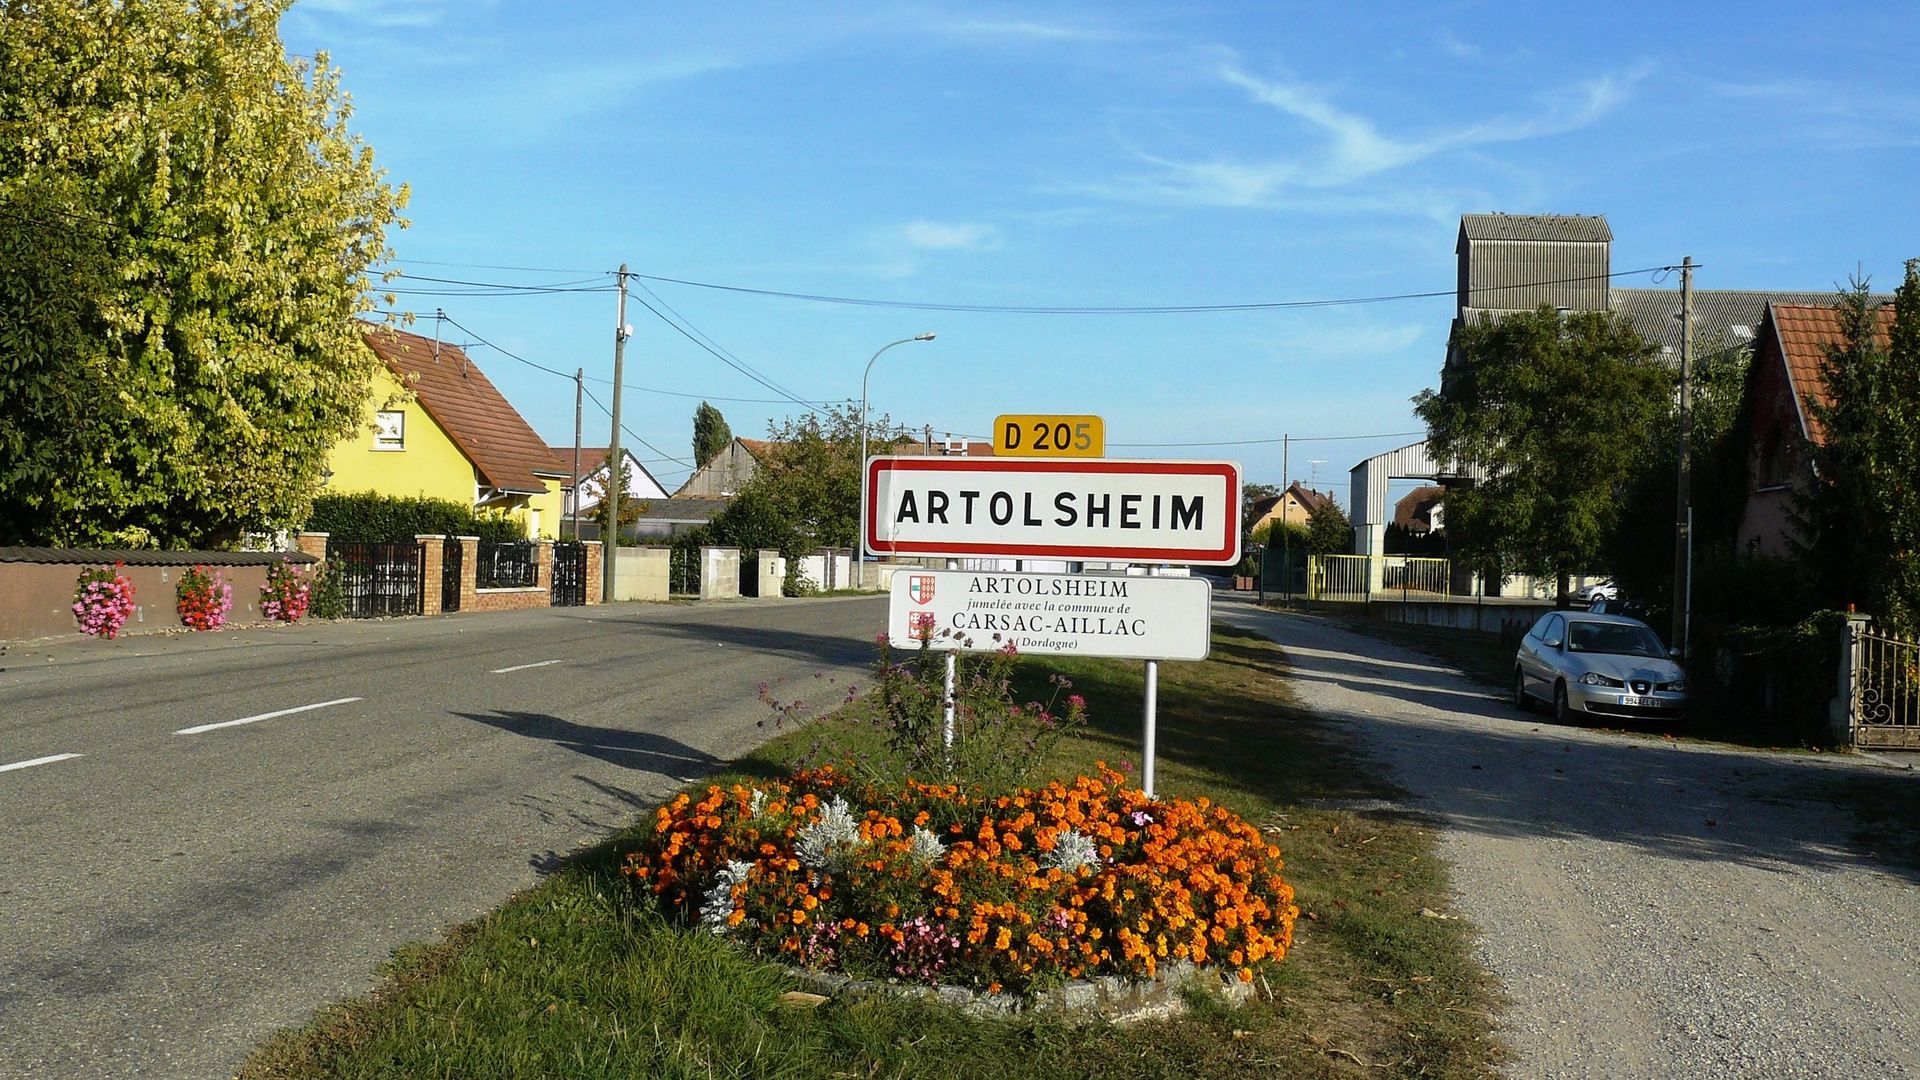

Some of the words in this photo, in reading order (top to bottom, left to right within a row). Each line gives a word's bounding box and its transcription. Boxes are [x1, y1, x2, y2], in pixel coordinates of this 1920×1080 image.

[1004, 422, 1021, 450] D
[1032, 422, 1092, 451] 205
[896, 489, 1204, 531] ARTOLSHEIM
[968, 576, 1129, 598] ARTOLSHEIM
[967, 600, 1013, 612] jumelée
[1015, 602, 1042, 611] avec
[1044, 600, 1056, 612] la
[1057, 603, 1114, 614] commune
[1116, 604, 1131, 614] de
[952, 612, 1146, 637] CARSAC-AILLAC
